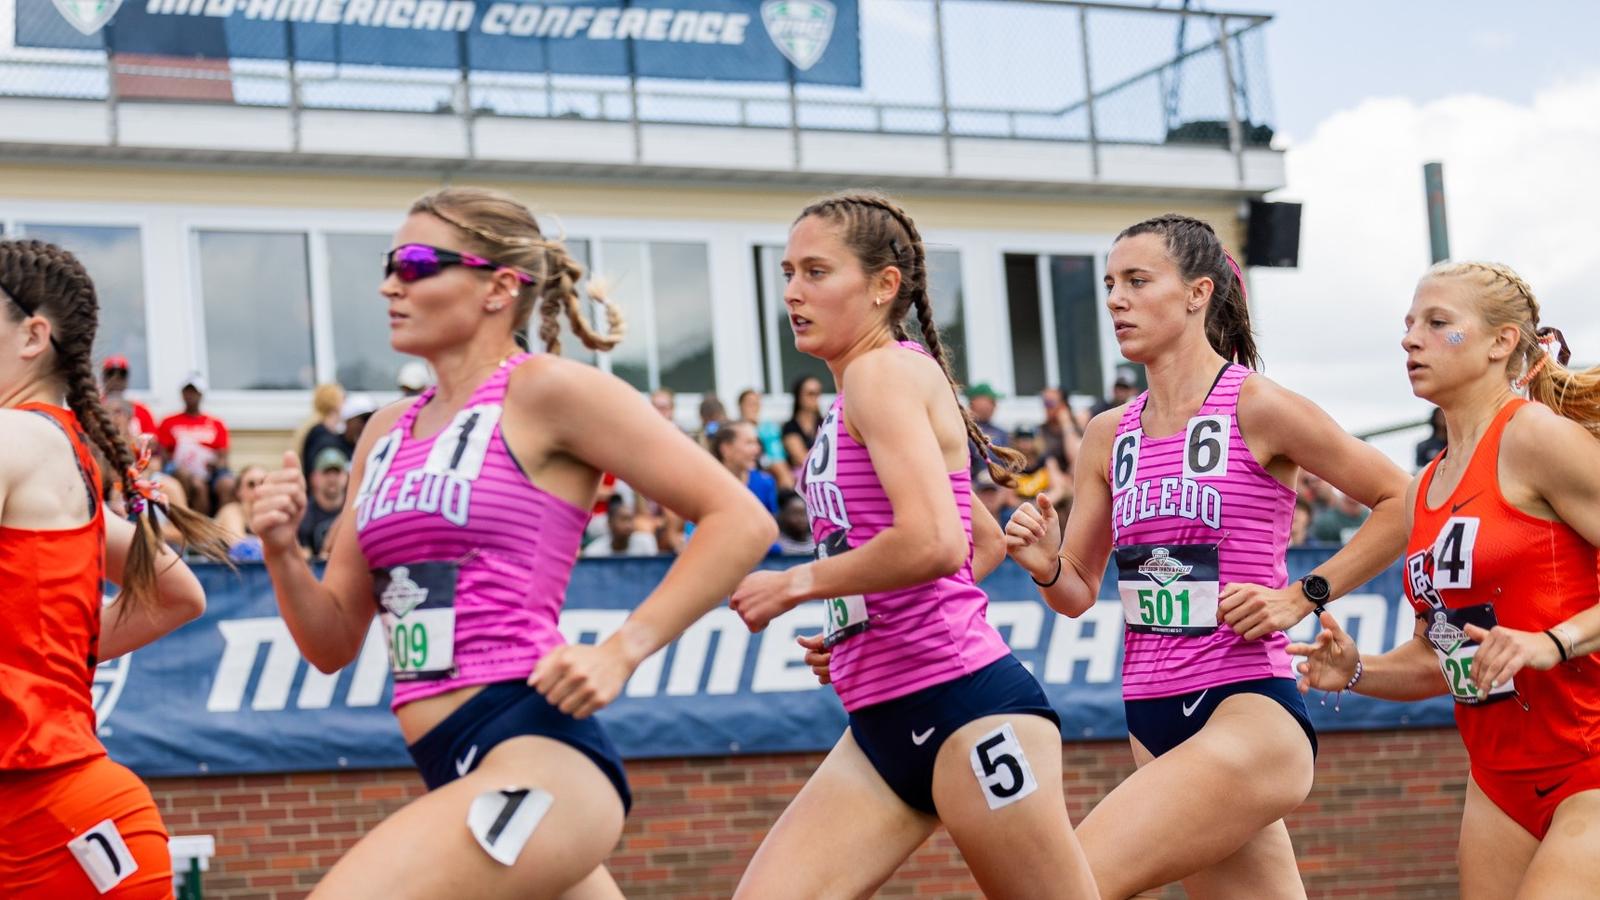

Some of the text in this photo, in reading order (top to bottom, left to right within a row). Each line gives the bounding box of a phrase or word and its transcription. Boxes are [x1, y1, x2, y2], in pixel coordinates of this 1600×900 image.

[480, 3, 751, 45] CONFERENCE
[449, 413, 480, 470] 1
[1114, 434, 1137, 490] 6
[1187, 419, 1222, 474] 6
[1111, 475, 1223, 542] TOLEDO
[1437, 521, 1465, 584] 4
[1136, 588, 1191, 627] 501
[975, 731, 1025, 799] 5
[484, 788, 531, 847] 1
